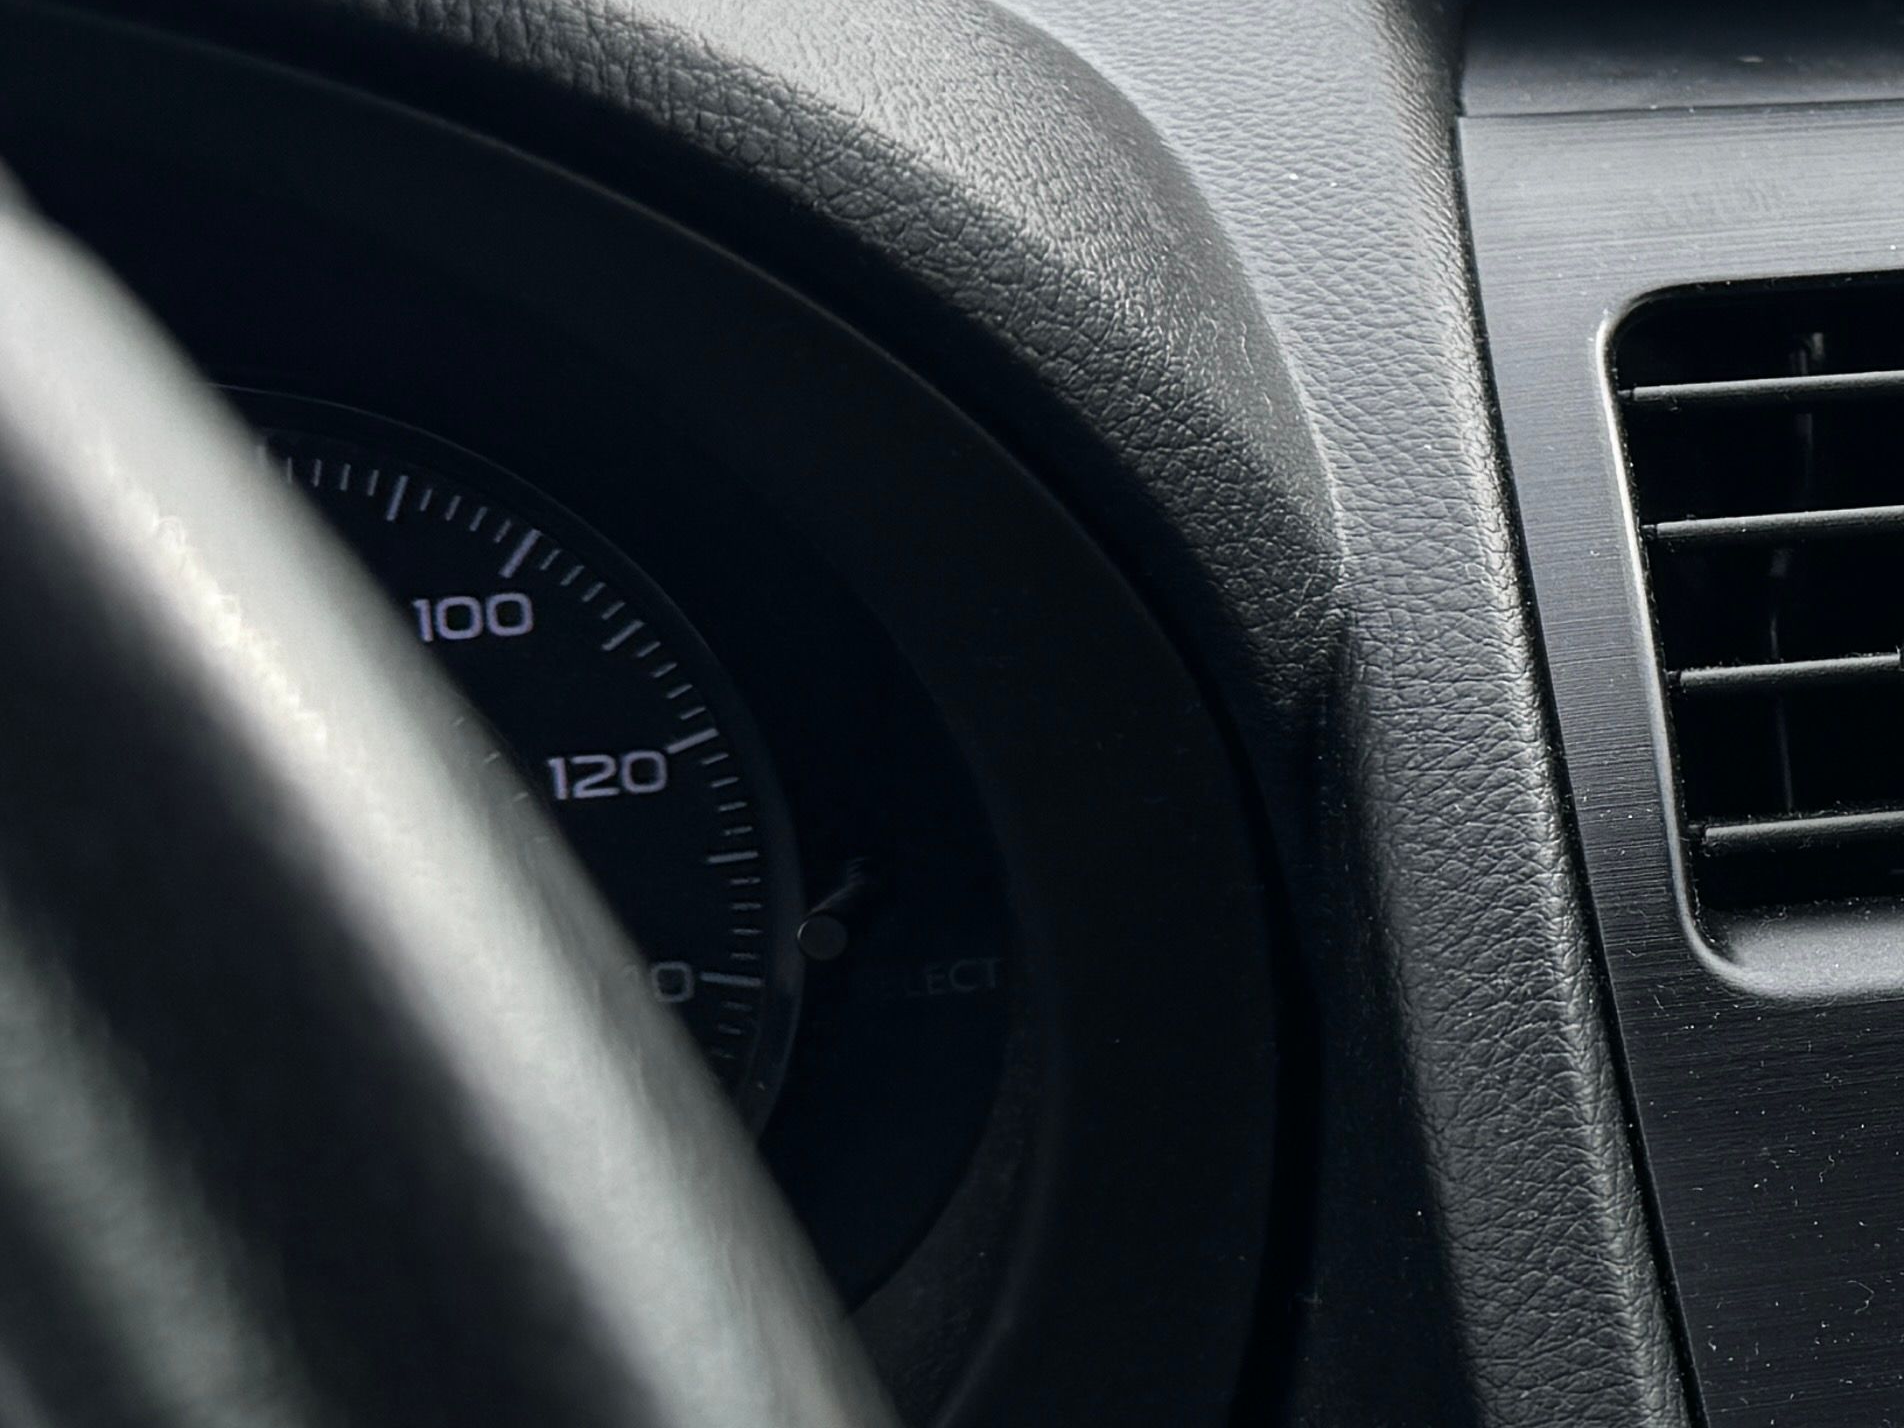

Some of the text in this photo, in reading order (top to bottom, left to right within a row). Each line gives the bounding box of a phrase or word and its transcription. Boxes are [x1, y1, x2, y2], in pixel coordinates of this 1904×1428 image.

[411, 591, 535, 643] 100
[547, 749, 669, 801] 120
[903, 956, 1003, 998] LECT
